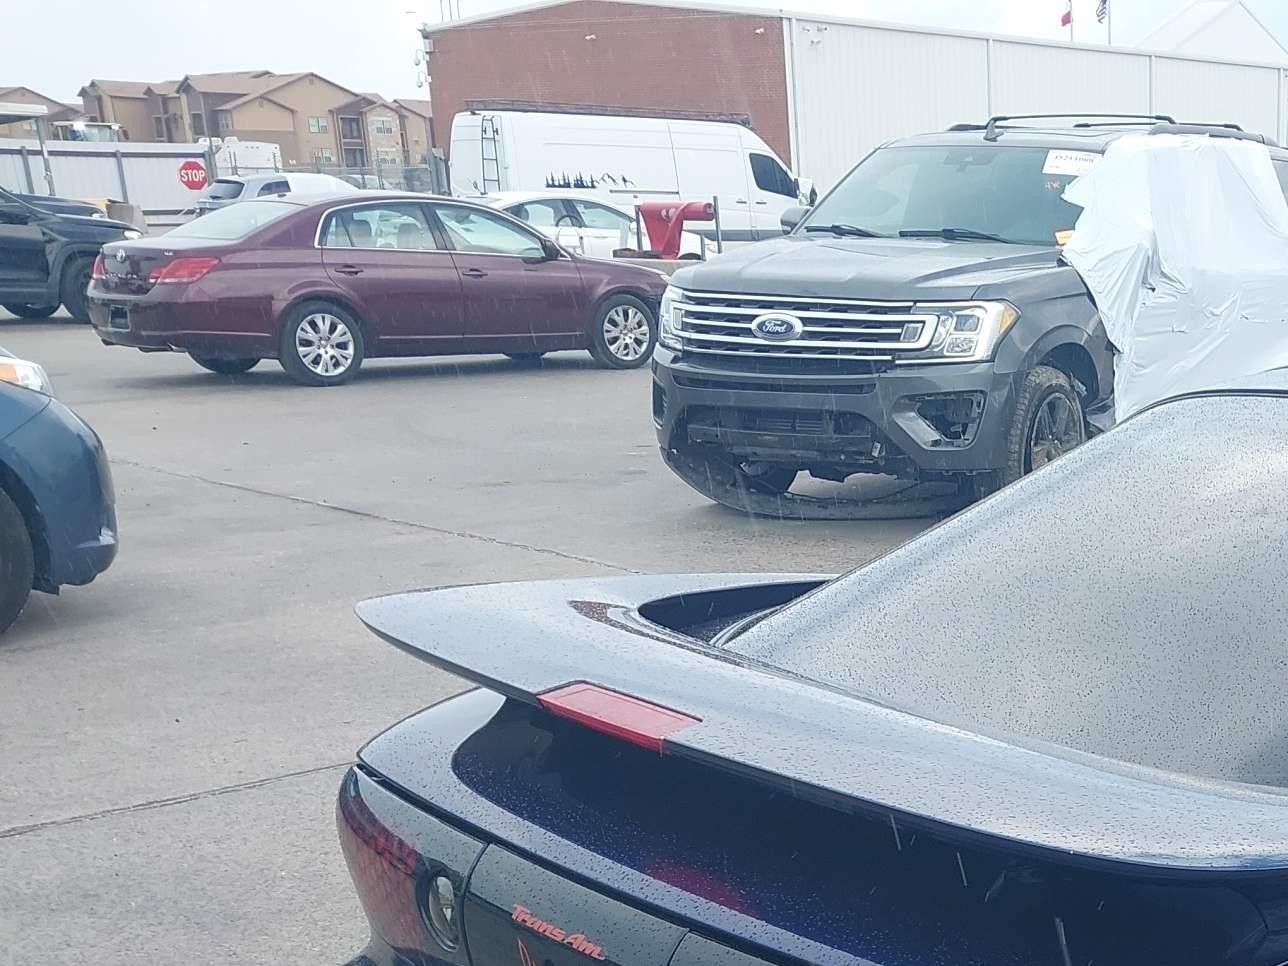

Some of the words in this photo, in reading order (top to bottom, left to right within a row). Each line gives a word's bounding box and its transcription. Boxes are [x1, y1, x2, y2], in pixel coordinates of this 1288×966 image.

[181, 169, 206, 182] STOP
[762, 320, 788, 333] Ford
[511, 902, 568, 943] Trans
[563, 932, 606, 961] Am
